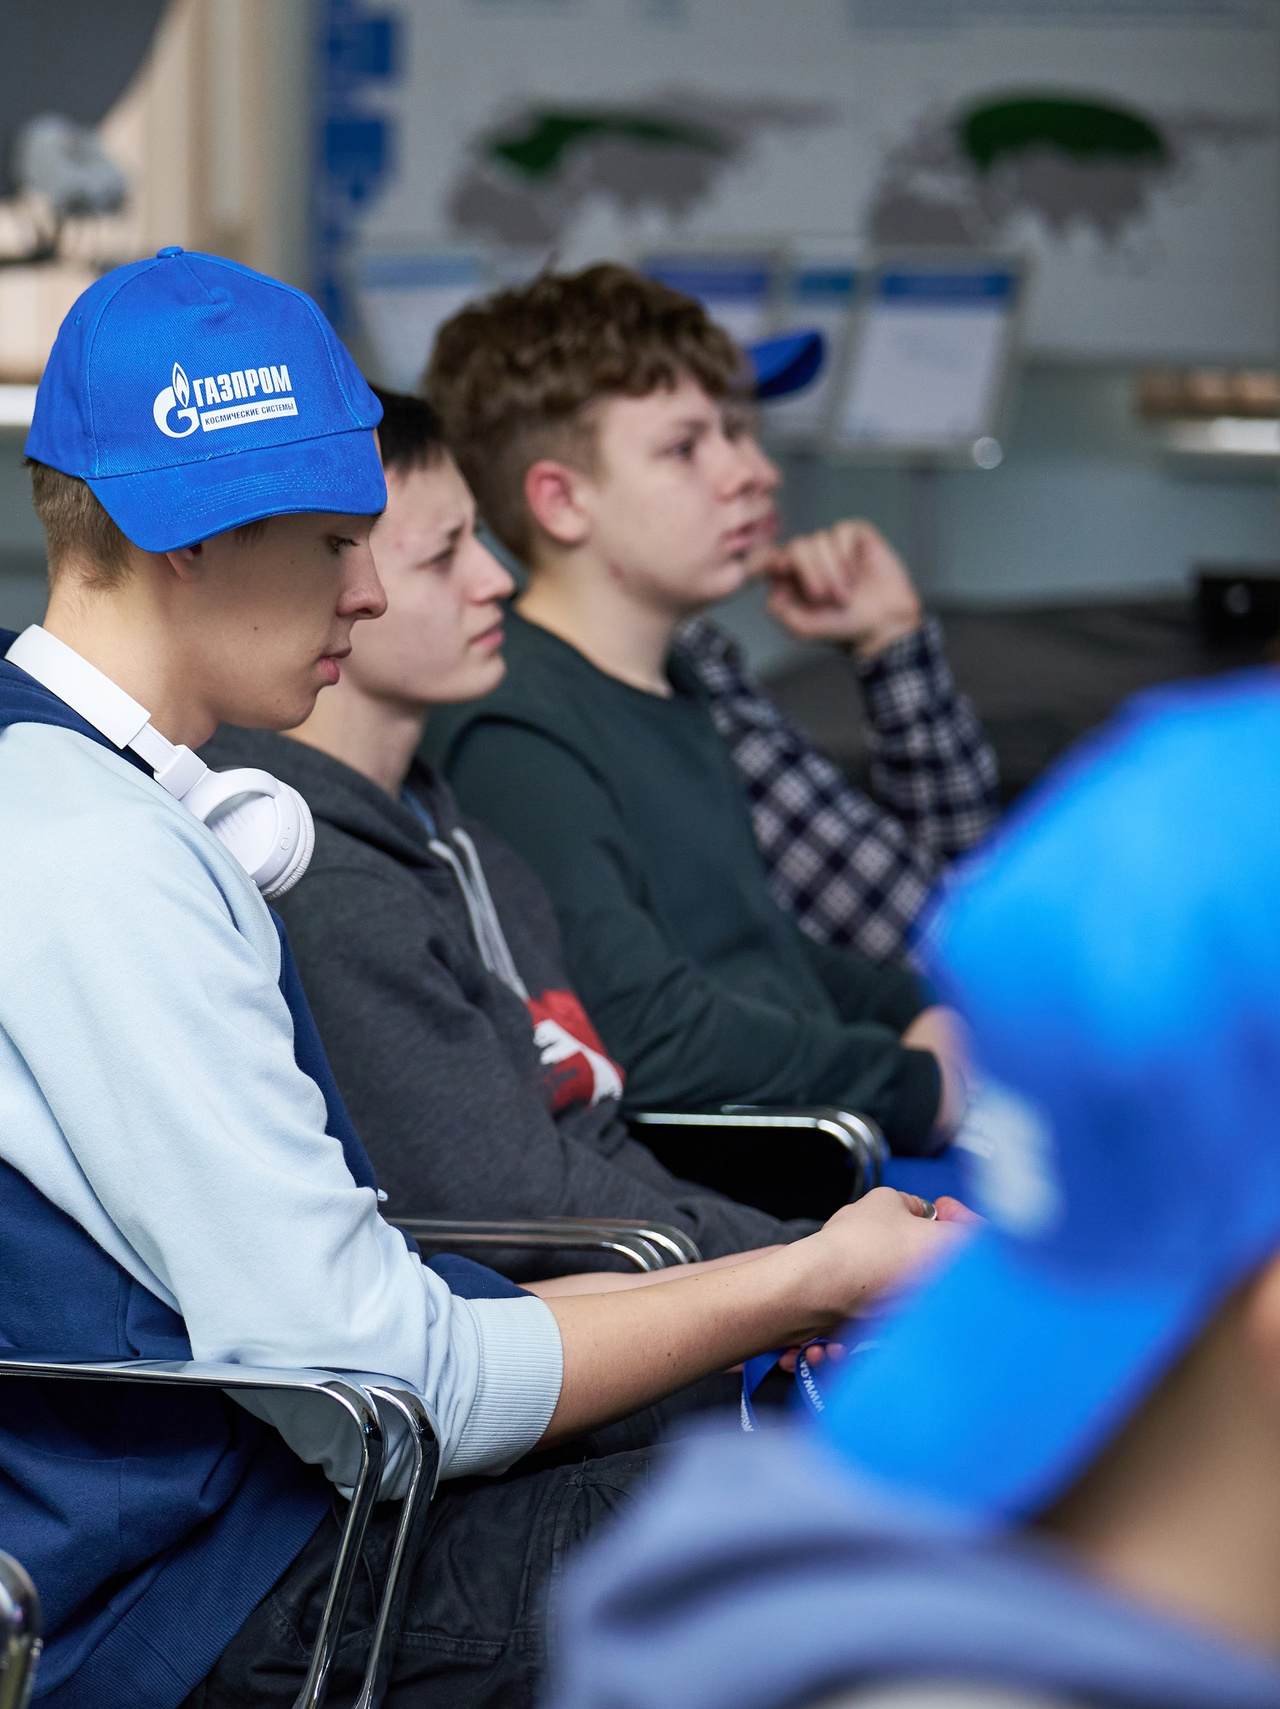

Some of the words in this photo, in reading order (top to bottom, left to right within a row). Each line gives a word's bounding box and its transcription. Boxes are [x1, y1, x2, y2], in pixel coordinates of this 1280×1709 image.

[192, 365, 292, 407] ГАЗПРОМ
[204, 408, 260, 426] КОСМИЧЕСКИЕ
[261, 402, 295, 415] СИСТЕМЫ
